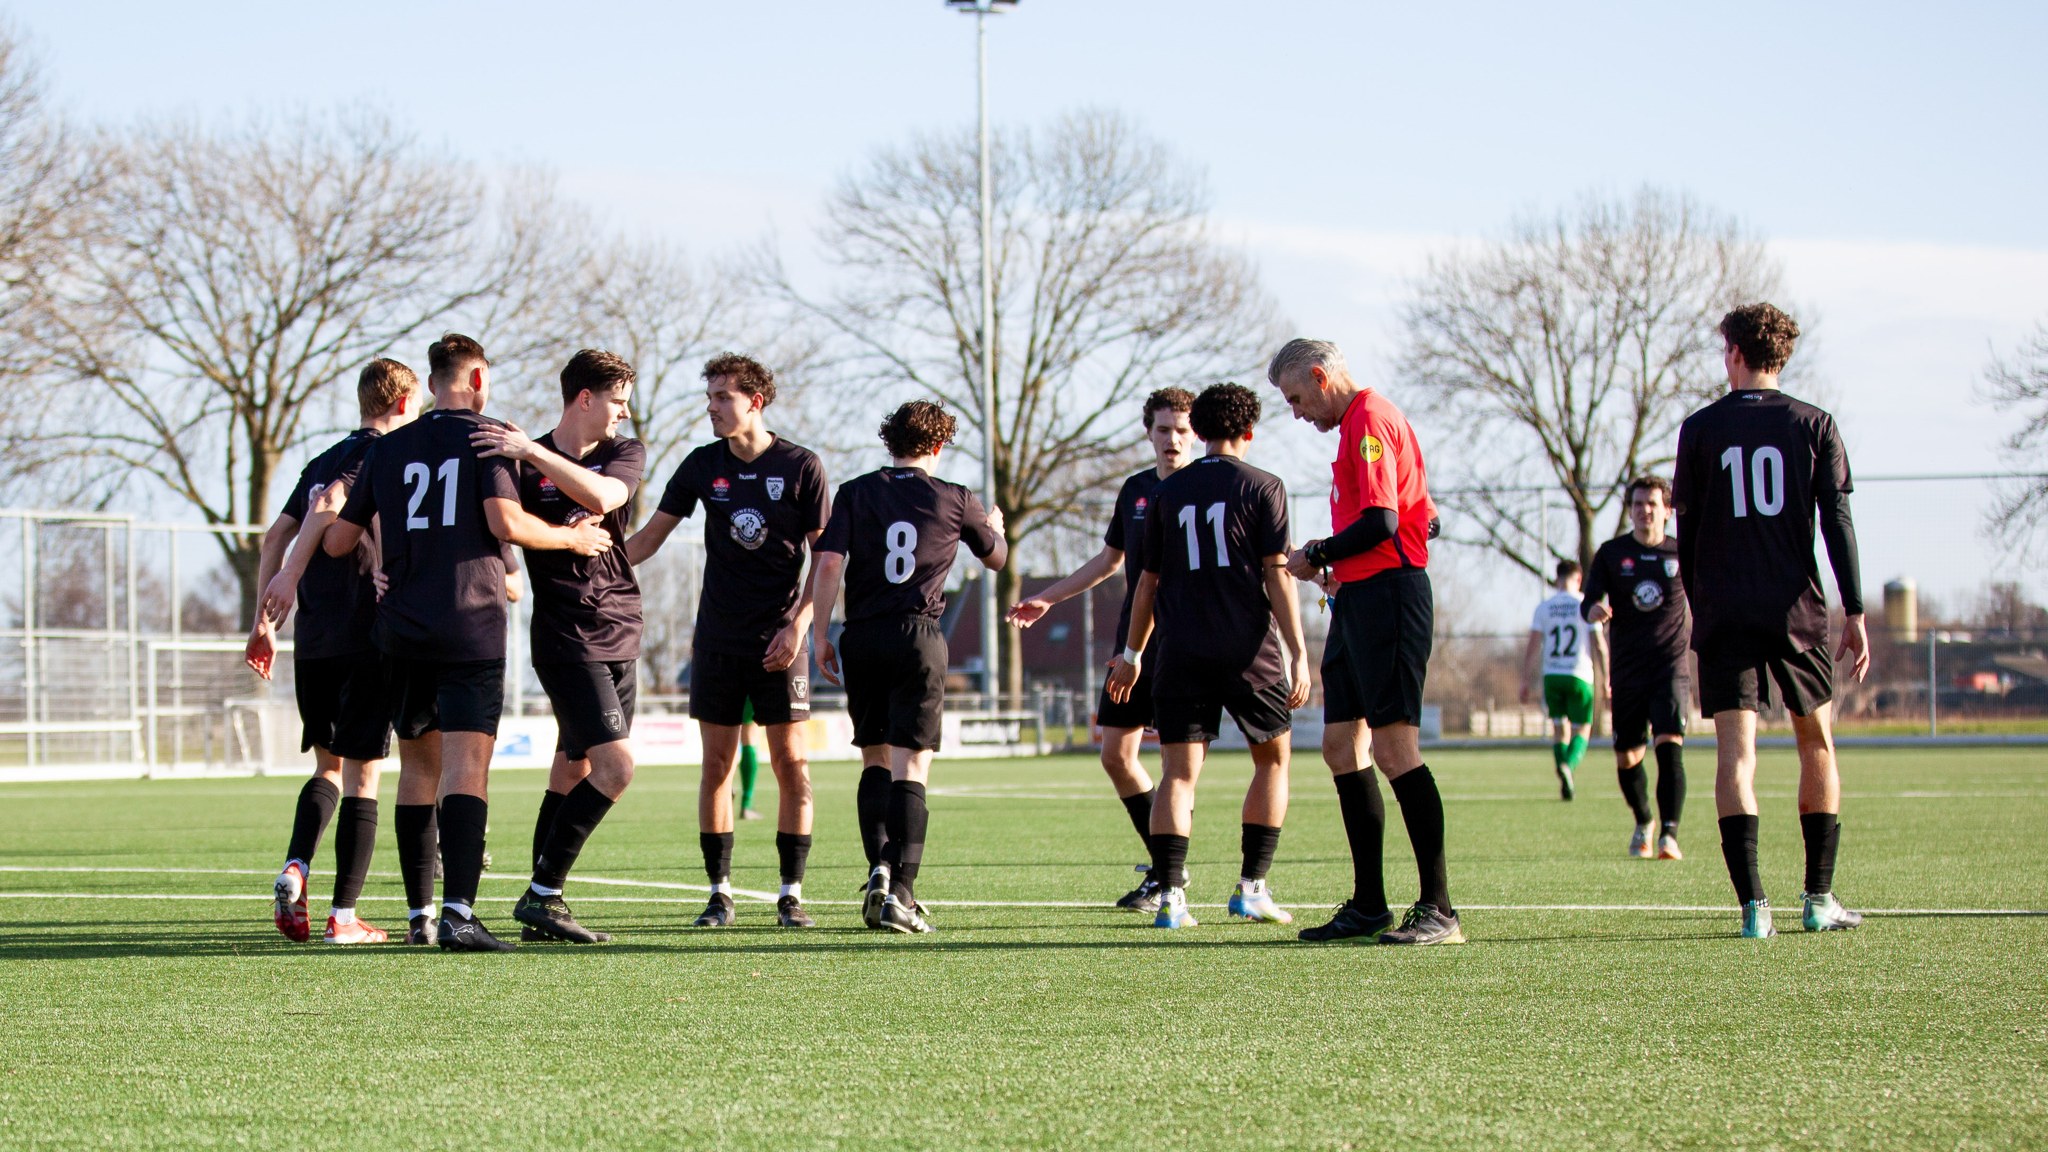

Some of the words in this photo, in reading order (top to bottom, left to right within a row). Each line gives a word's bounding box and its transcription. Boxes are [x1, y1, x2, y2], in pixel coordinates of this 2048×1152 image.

[404, 458, 460, 531] 21
[1721, 446, 1785, 518] 10
[730, 508, 766, 524] USINESSCLUB
[1178, 502, 1230, 571] 11
[884, 521, 918, 585] 8
[1550, 624, 1577, 657] 12
